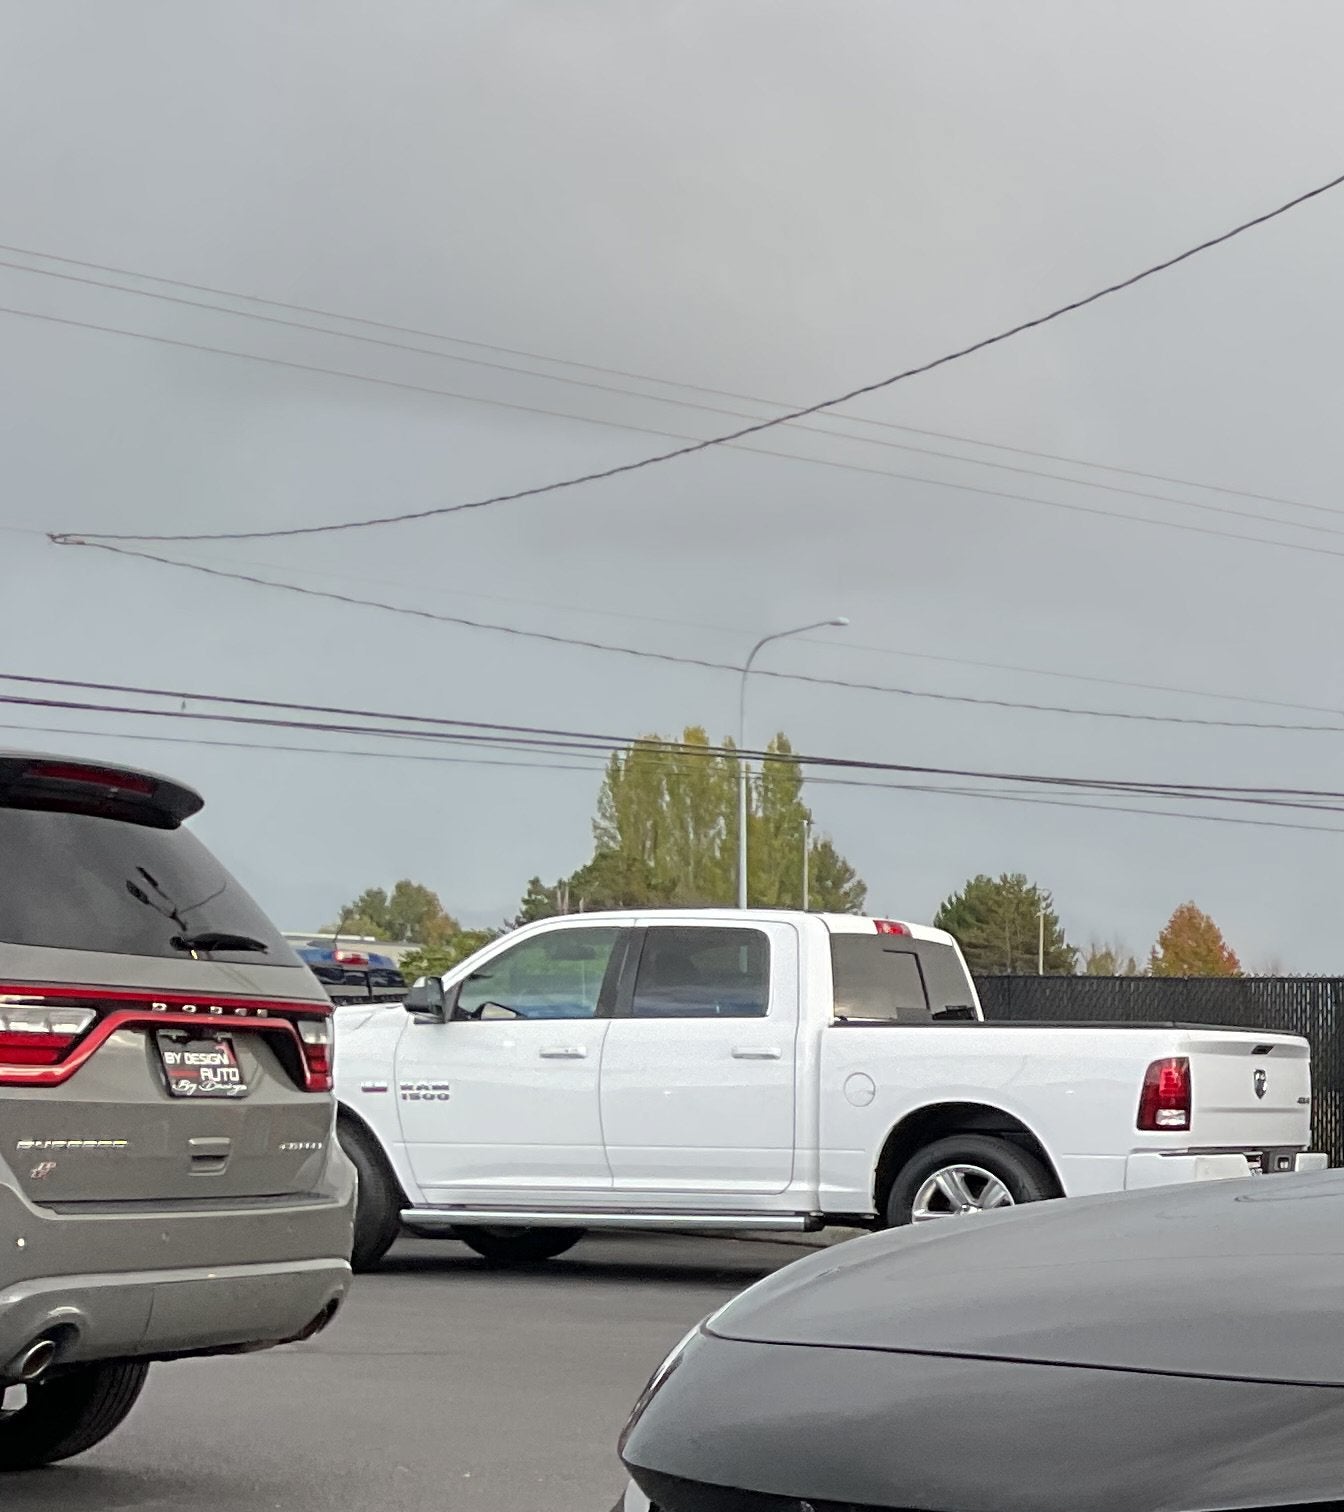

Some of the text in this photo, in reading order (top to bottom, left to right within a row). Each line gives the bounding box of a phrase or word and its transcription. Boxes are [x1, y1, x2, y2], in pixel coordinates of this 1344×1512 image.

[163, 1051, 230, 1065] BY DESIGN
[200, 1067, 240, 1082] AUTO
